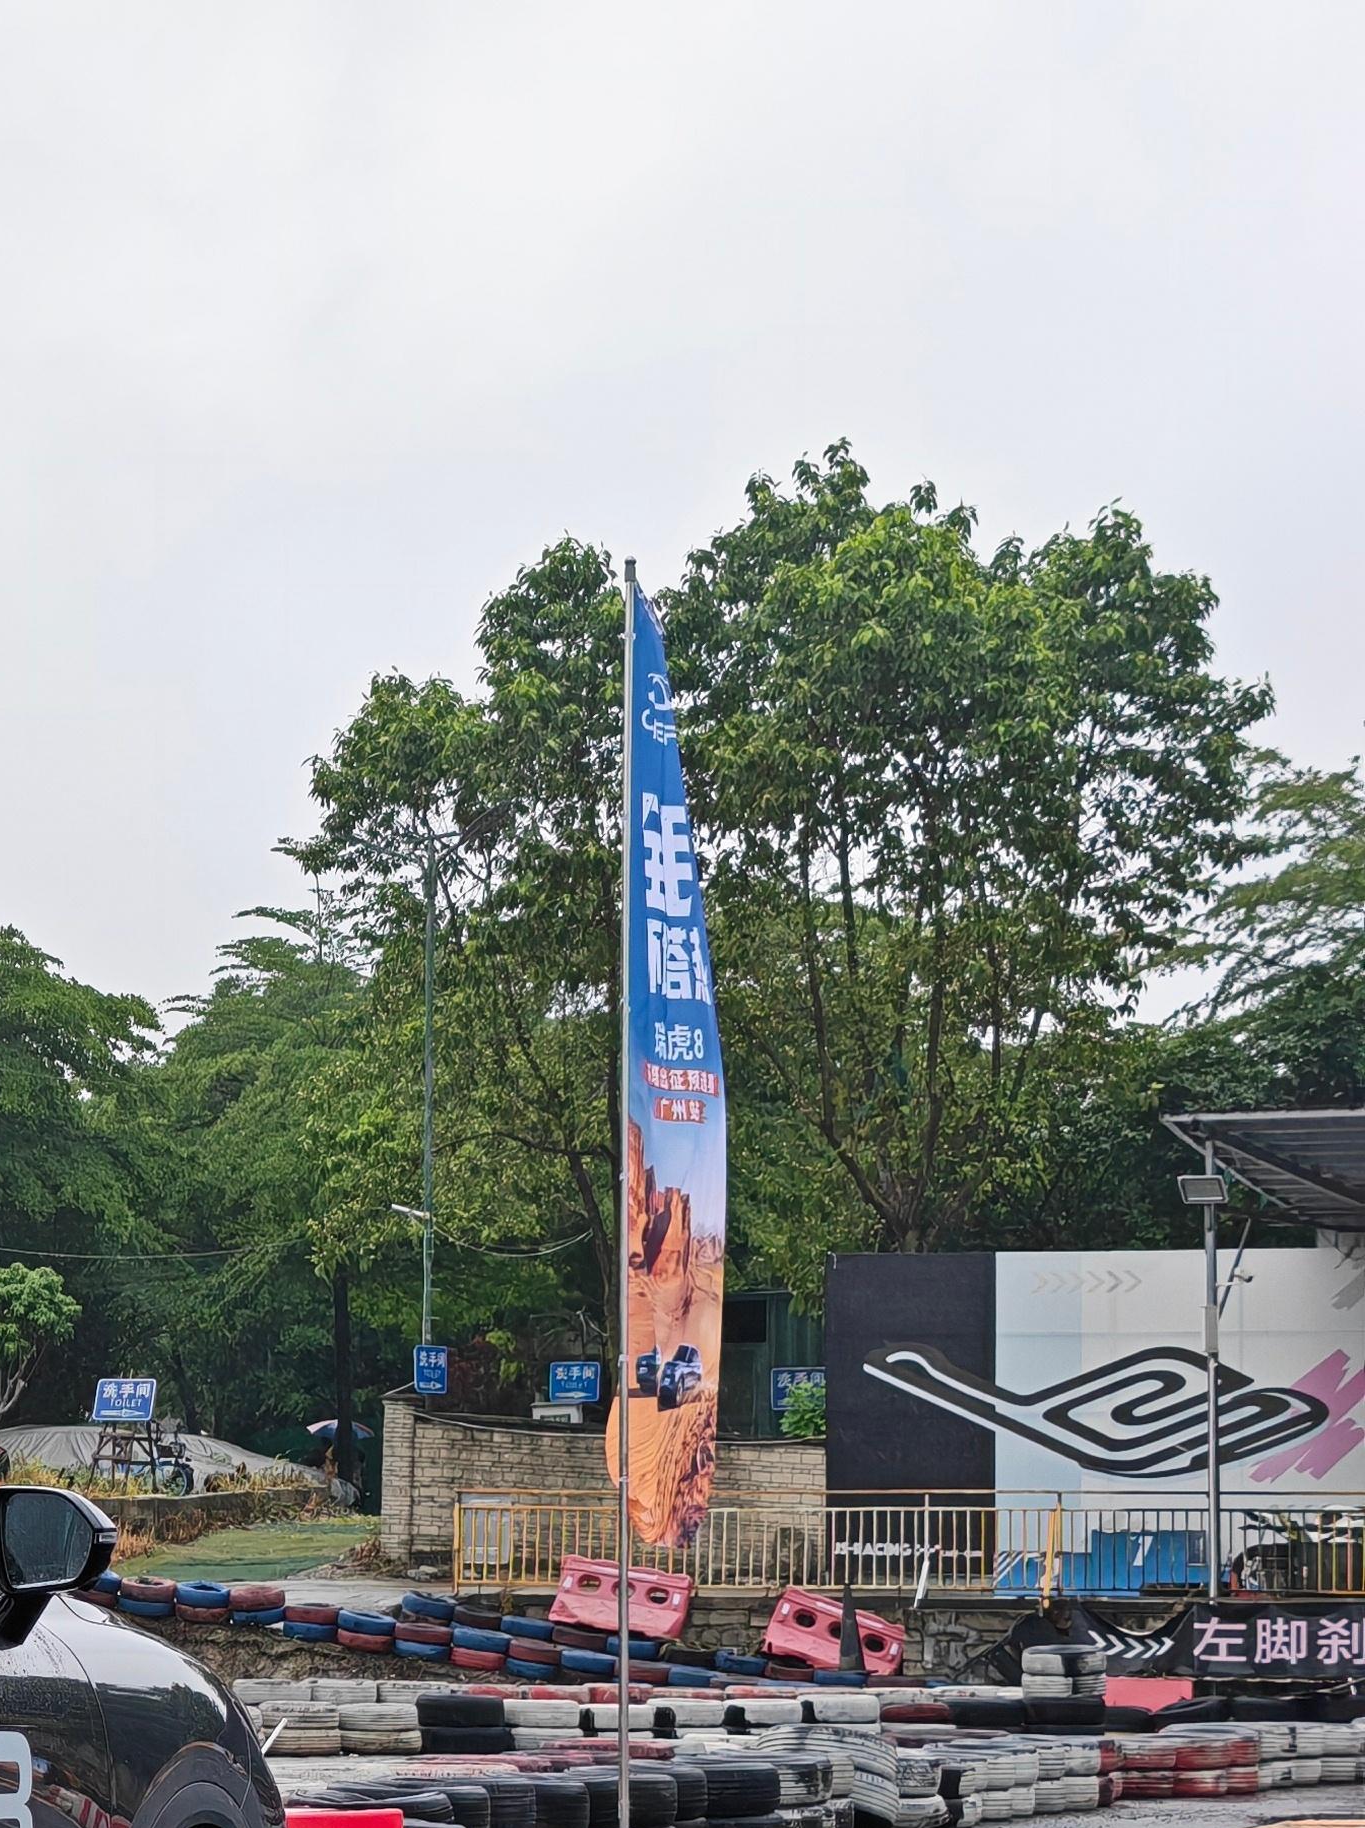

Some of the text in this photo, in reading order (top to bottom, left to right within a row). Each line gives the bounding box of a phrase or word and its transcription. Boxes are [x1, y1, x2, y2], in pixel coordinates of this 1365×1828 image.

[102, 1382, 151, 1398] 洗手间
[1193, 1616, 1365, 1664] 左脚刹
